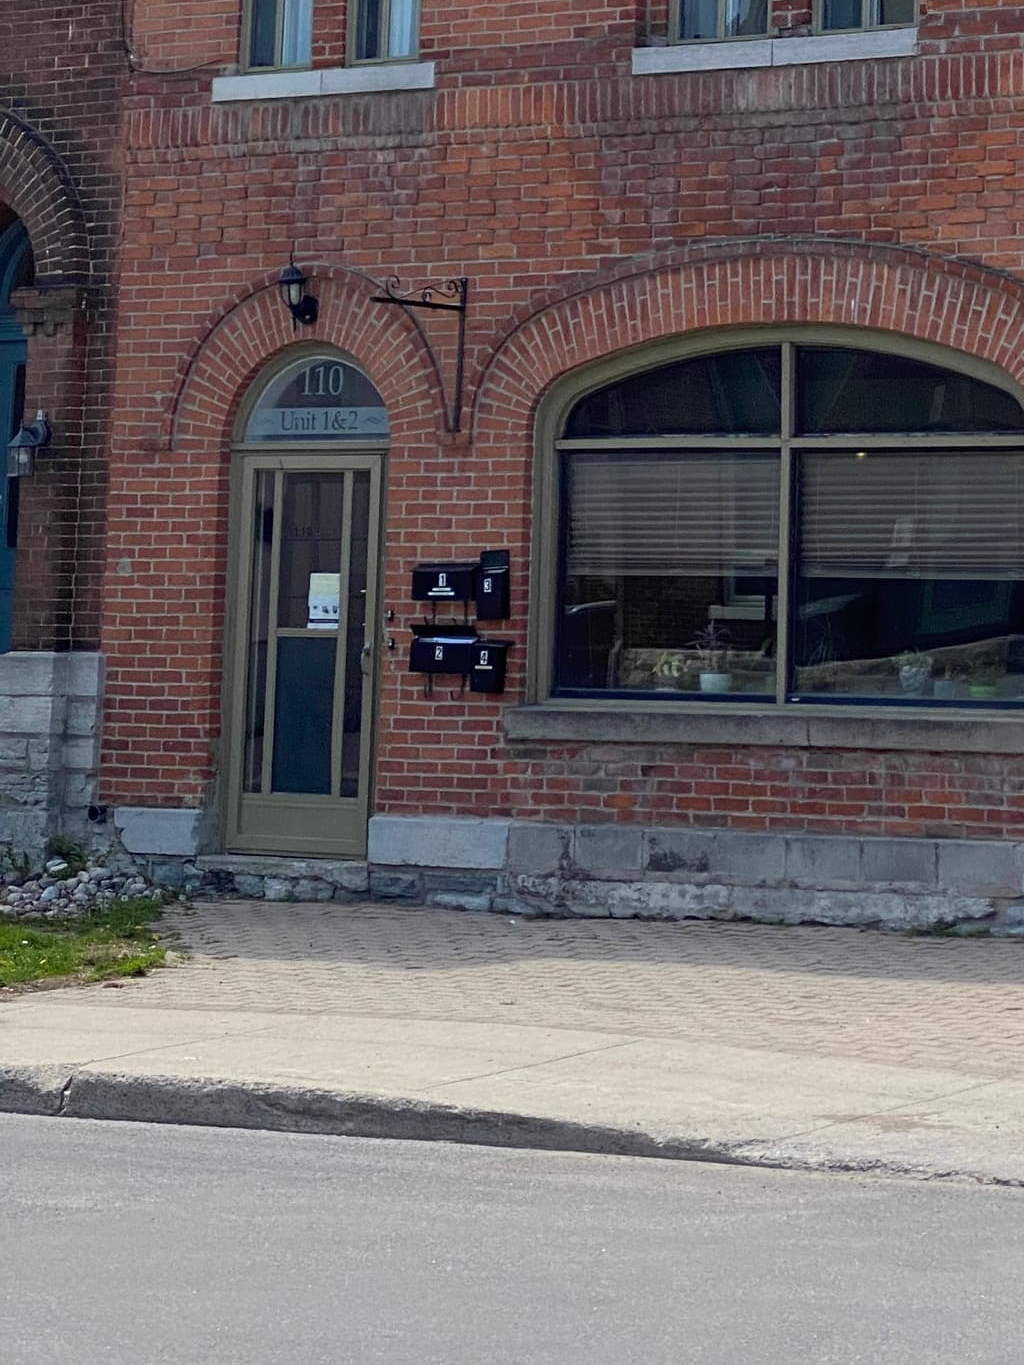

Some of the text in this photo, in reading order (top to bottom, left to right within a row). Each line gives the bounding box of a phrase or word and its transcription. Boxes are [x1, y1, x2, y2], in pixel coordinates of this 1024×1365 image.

[300, 365, 344, 395] 110
[280, 411, 358, 431] Unit 1&2
